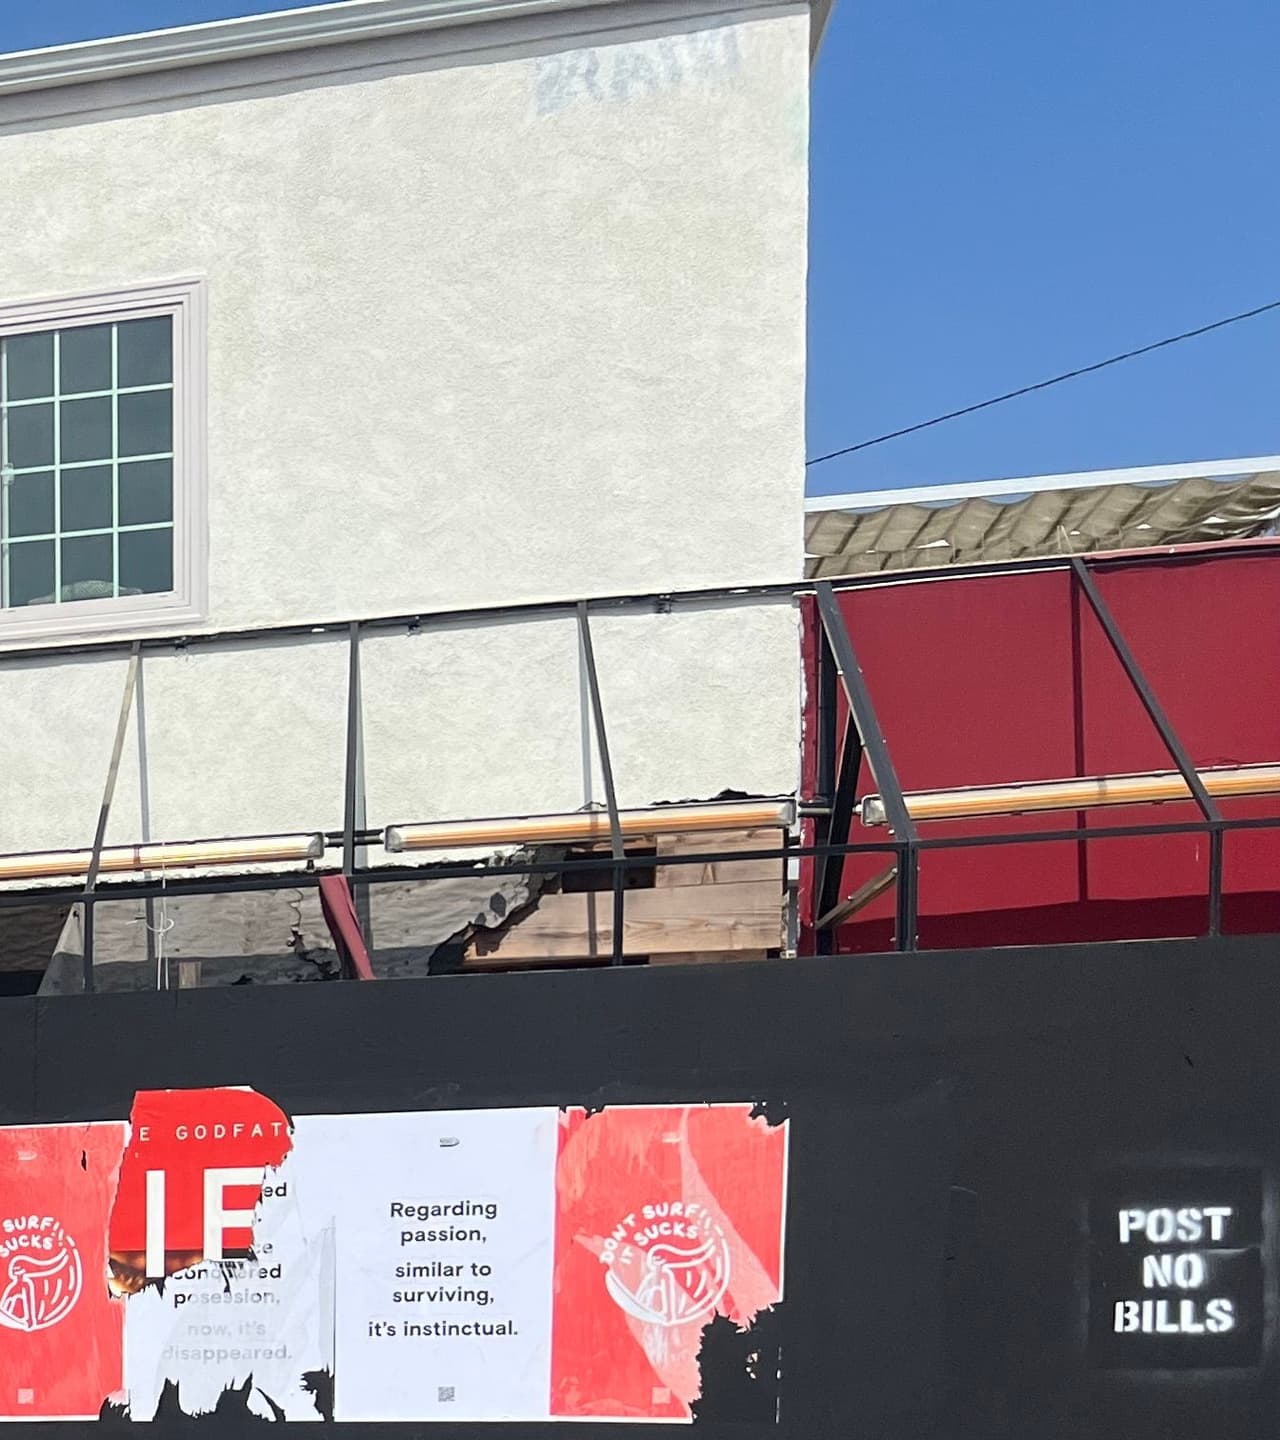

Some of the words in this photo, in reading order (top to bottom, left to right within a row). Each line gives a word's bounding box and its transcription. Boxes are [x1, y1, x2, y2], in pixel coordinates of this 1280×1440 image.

[390, 1200, 497, 1221] Regarding
[633, 1221, 699, 1246] SUCKS
[1118, 1206, 1232, 1243] POST
[401, 1225, 487, 1246] passion,
[395, 1262, 464, 1278] similar
[470, 1262, 491, 1277] to
[1143, 1253, 1204, 1289] NO
[392, 1286, 495, 1306] surviving,
[1113, 1299, 1235, 1333] BILLS
[368, 1321, 397, 1337] it's
[403, 1320, 519, 1336] instinctual.
[161, 1344, 293, 1365] disappeared.
